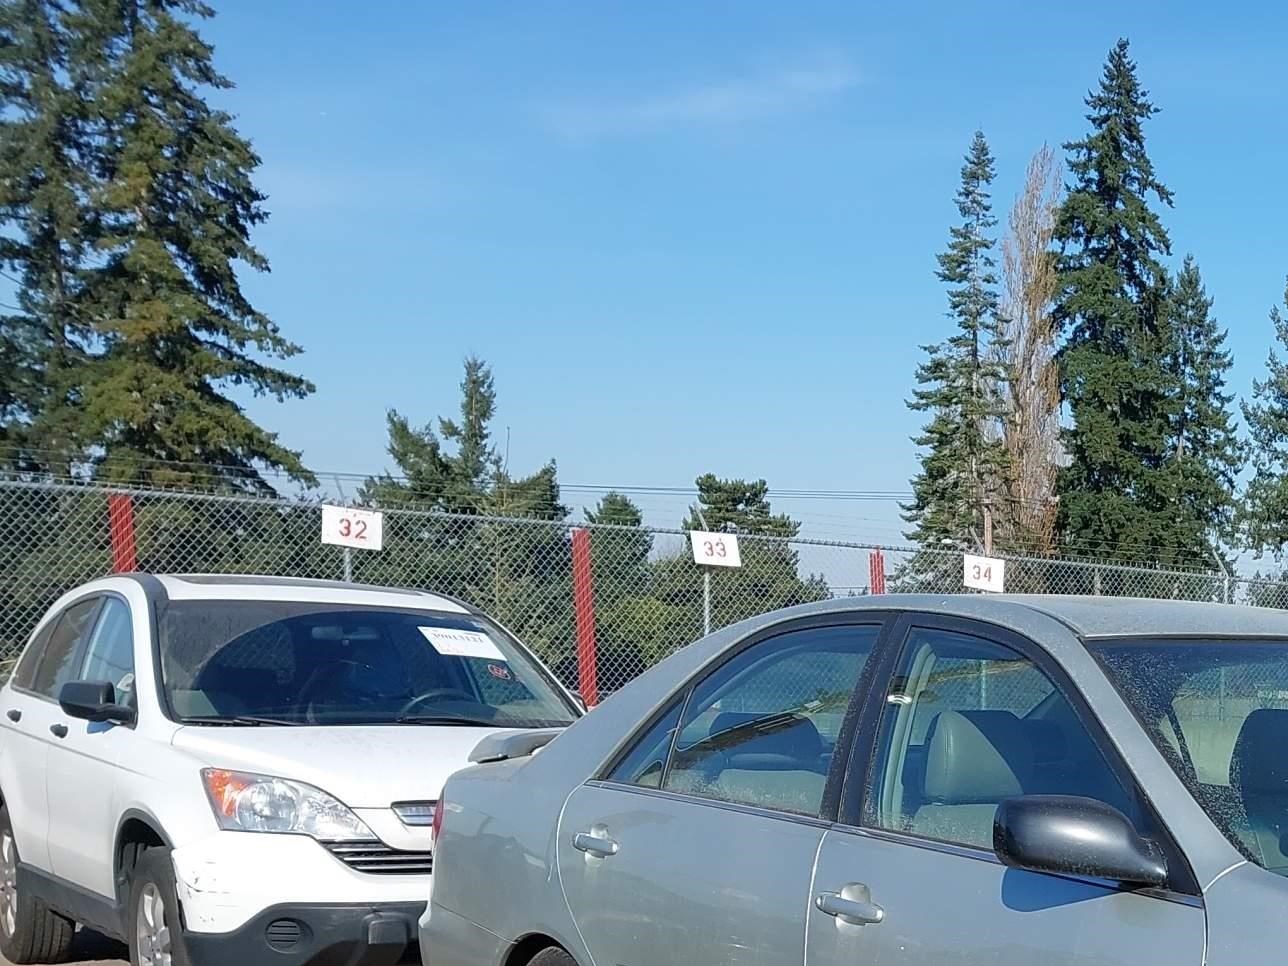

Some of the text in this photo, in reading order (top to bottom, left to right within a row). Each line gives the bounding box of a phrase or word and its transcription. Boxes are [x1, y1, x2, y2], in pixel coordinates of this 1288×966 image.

[339, 518, 367, 540] 32
[704, 541, 727, 558] 33
[972, 565, 992, 582] 34
